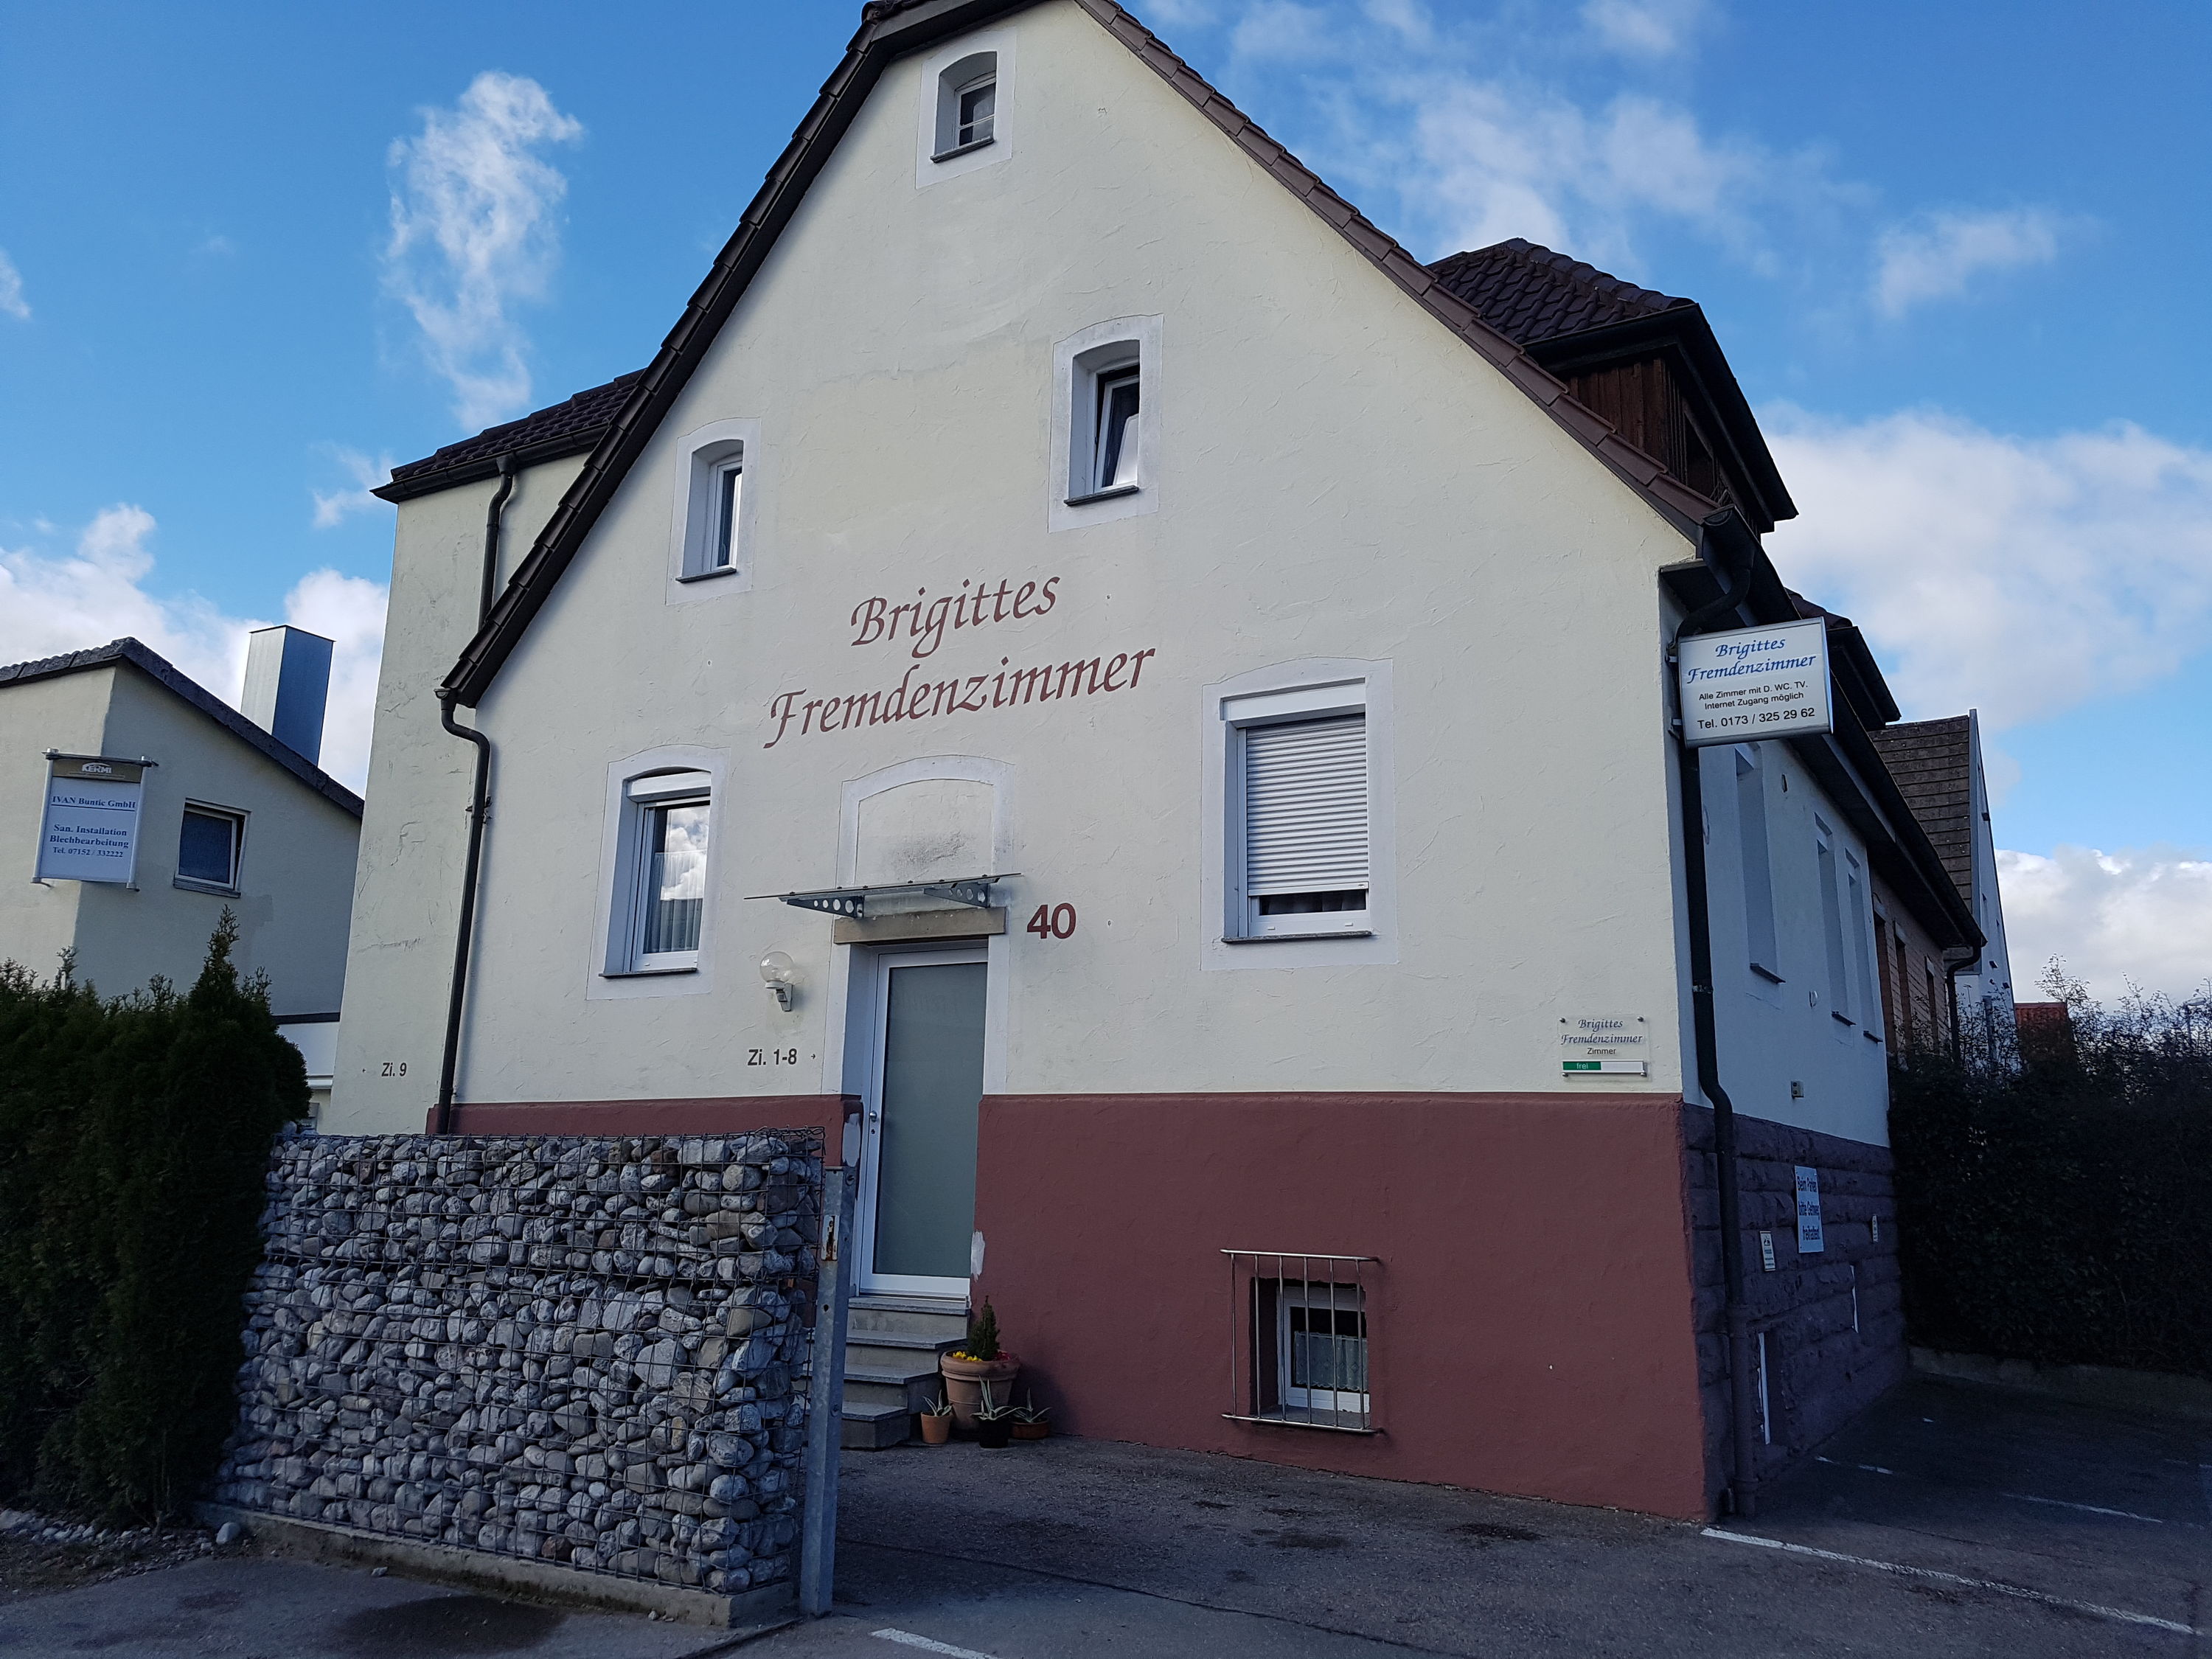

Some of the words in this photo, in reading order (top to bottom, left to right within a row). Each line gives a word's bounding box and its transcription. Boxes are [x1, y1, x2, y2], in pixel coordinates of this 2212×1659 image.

[850, 576, 1060, 658] Brigittes
[1714, 638, 1786, 660] Brigittes
[1686, 655, 1816, 684] Fremdenzimmer
[763, 647, 1156, 749] Fremdenzimmer
[1716, 688, 1747, 699] Zimmer
[1748, 686, 1761, 695] mit
[1704, 700, 1736, 710] Internet
[1737, 698, 1769, 707] Zugang
[1770, 692, 1804, 703] möglich
[1697, 719, 1718, 729] Tel.
[1721, 715, 1748, 727] 0173
[1751, 714, 1756, 724] /
[1759, 711, 1780, 723] 325
[1783, 709, 1798, 720] 29
[1801, 707, 1815, 718] 62
[82, 762, 112, 773] KERMI
[78, 798, 105, 806] Buntic
[108, 800, 136, 808] GmbH
[54, 824, 74, 832] San.
[76, 825, 128, 836] Installation
[49, 835, 129, 849] Blechbearbeitung
[1026, 902, 1077, 939] 40
[1578, 1019, 1623, 1032] Brigittes
[1560, 1033, 1643, 1045] Fremdenzimmer
[747, 1048, 767, 1066] Zi.
[773, 1048, 798, 1065] 1-8
[1587, 1047, 1616, 1055] Zimmer
[381, 1062, 395, 1077] Zi.
[399, 1062, 407, 1077] 9
